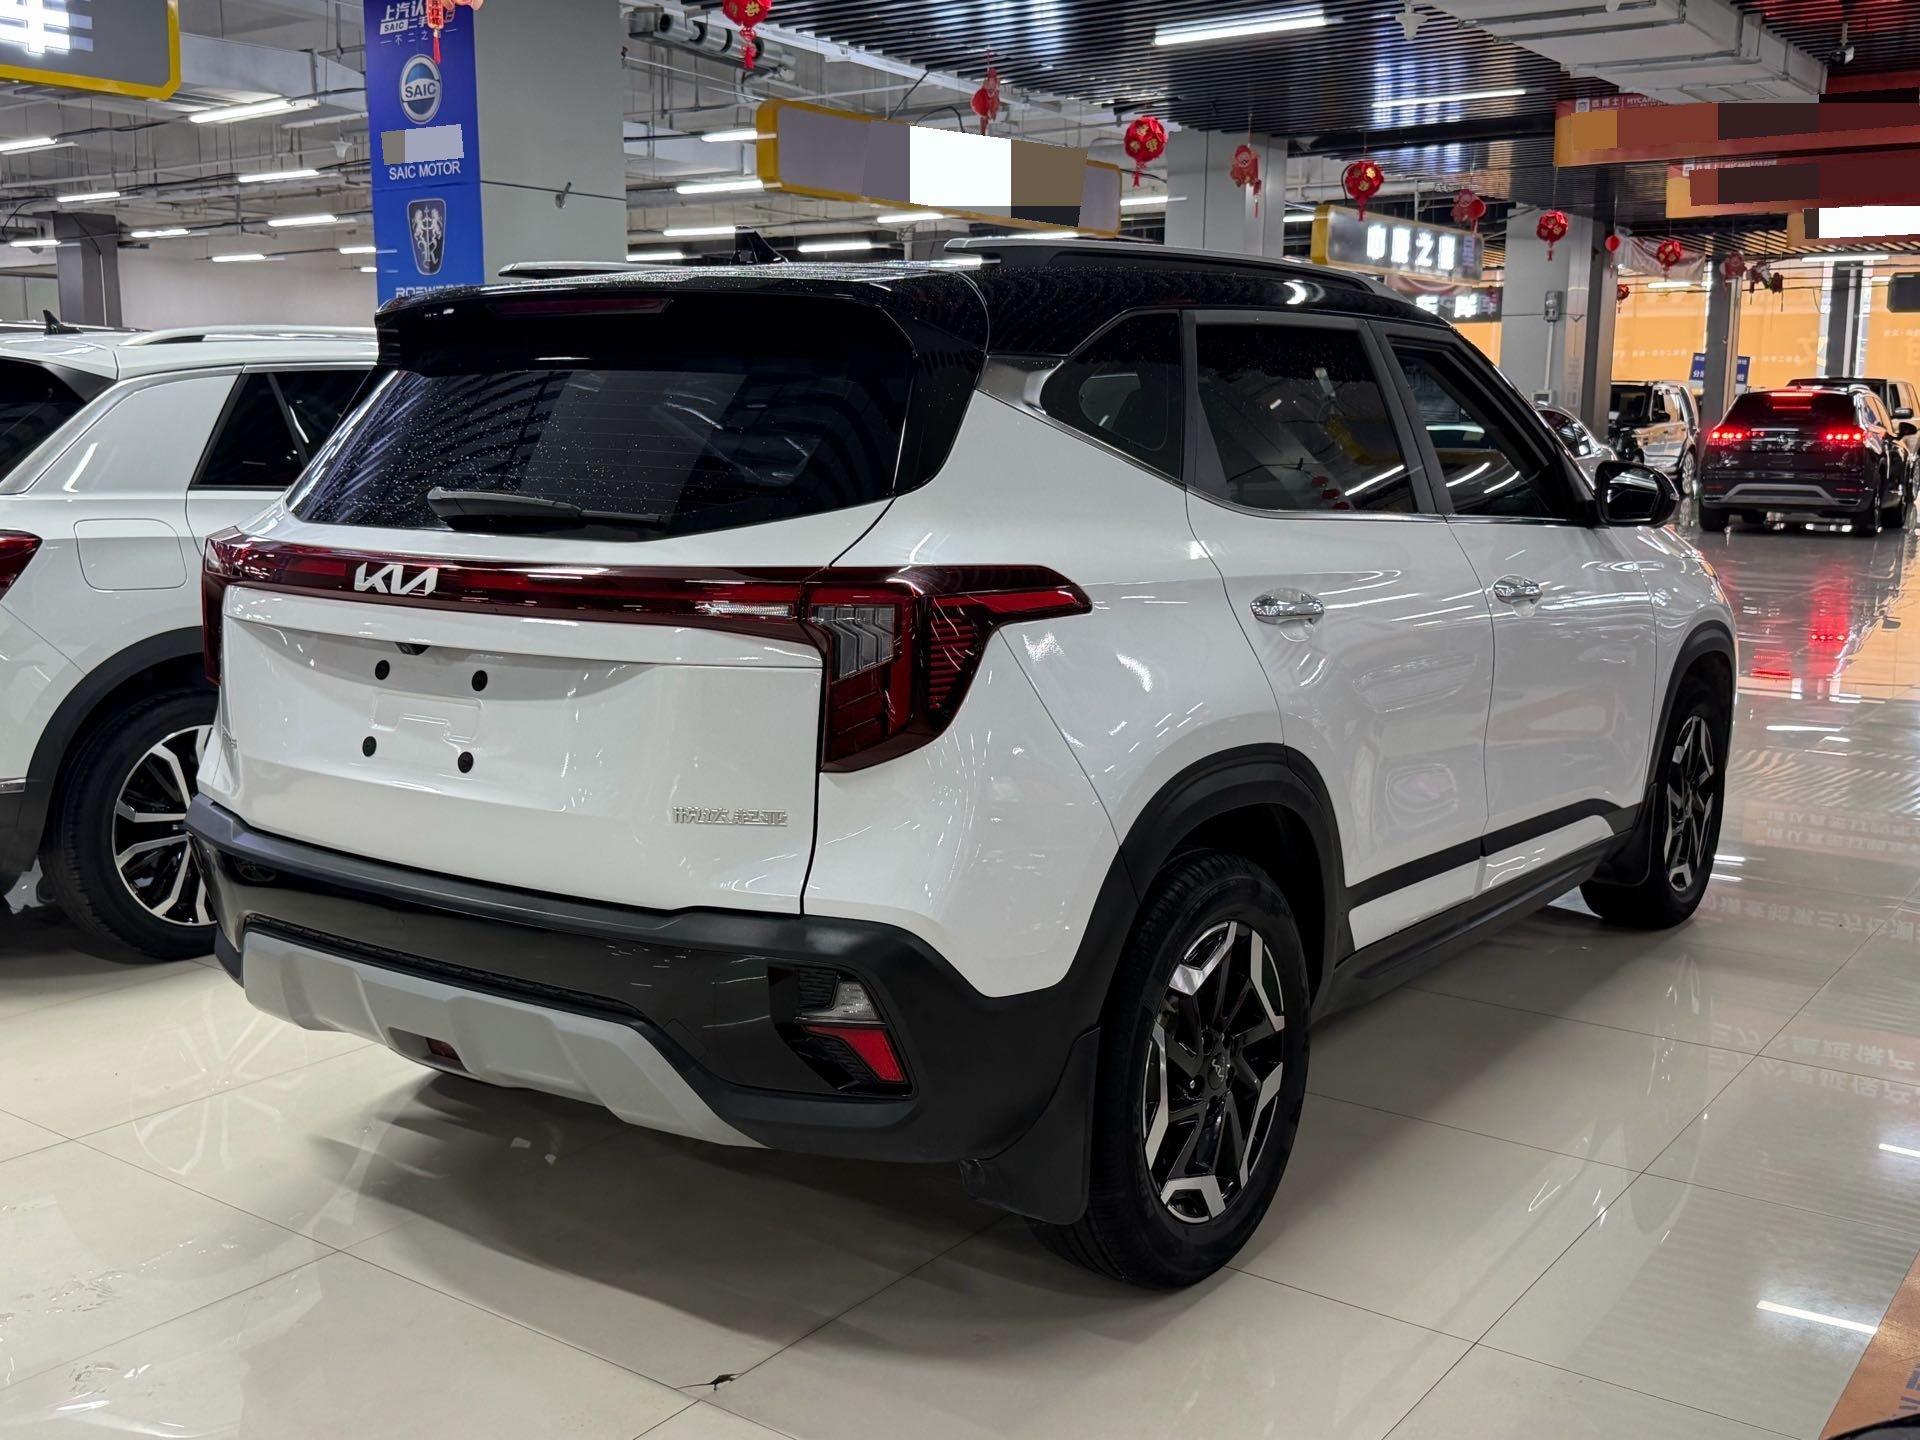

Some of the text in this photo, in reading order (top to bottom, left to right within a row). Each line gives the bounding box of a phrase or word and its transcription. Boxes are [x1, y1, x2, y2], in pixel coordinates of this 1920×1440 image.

[381, 0, 425, 22] 上汽认
[384, 22, 405, 32] SAIC
[405, 82, 437, 98] SAIC
[389, 161, 461, 181] SAIC MOTOR
[354, 562, 439, 597] KIA
